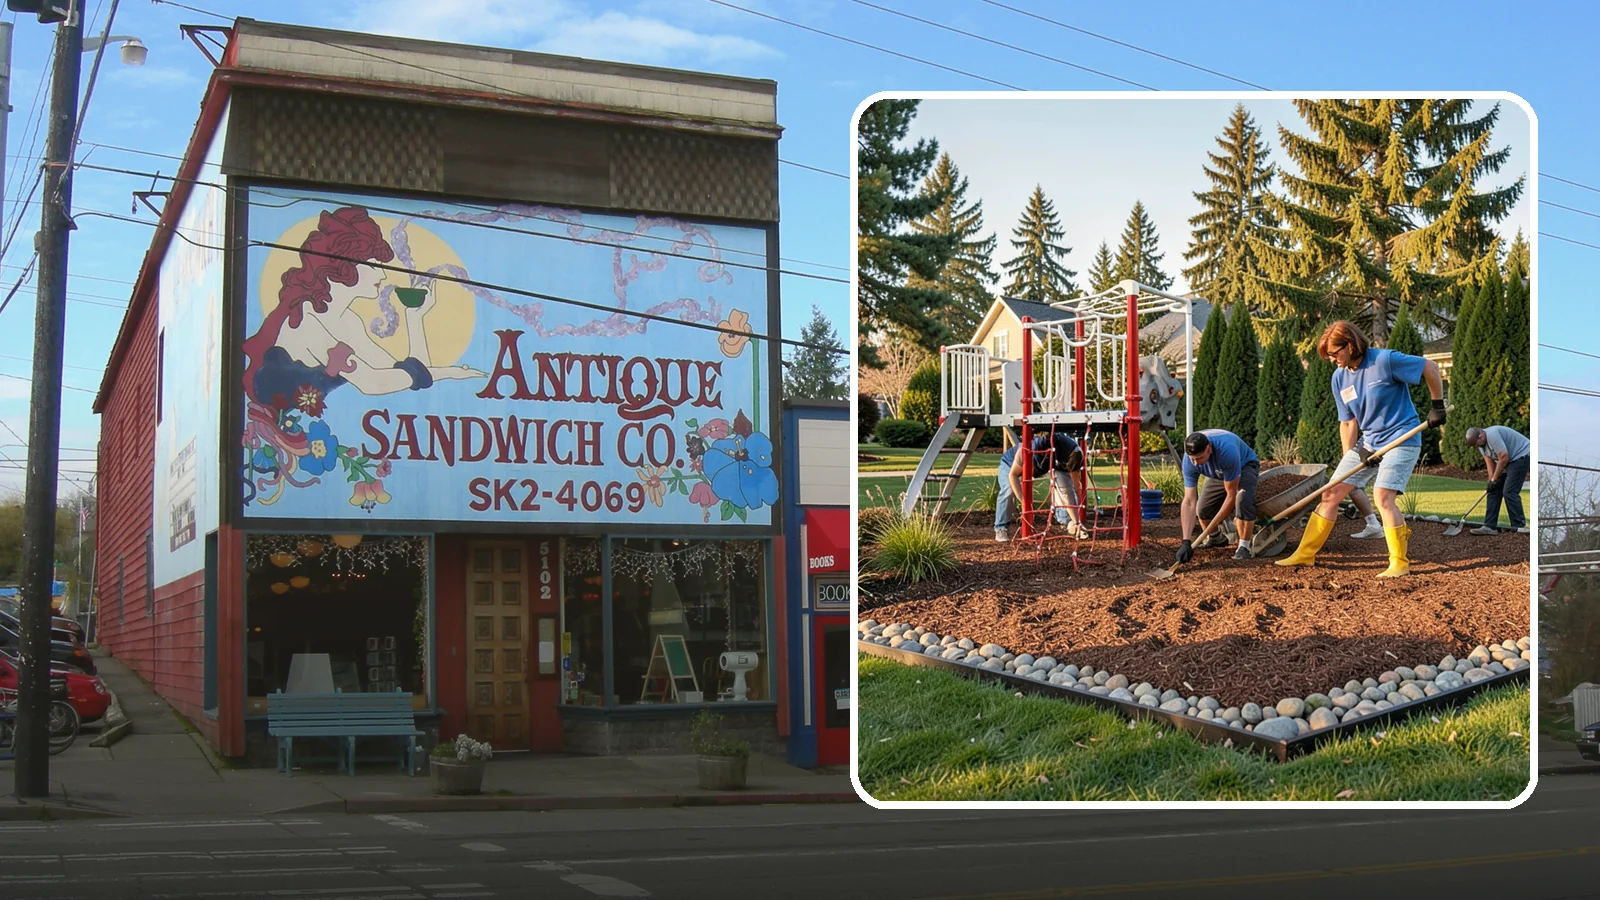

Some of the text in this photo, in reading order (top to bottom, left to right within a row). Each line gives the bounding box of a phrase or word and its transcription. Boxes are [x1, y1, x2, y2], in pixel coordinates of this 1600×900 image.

[476, 329, 724, 420] ANTIQUE
[362, 409, 684, 469] SANDWICH CO.
[468, 477, 645, 512] SK2-4069
[540, 541, 551, 600] 5102
[809, 555, 835, 569] BOOKS
